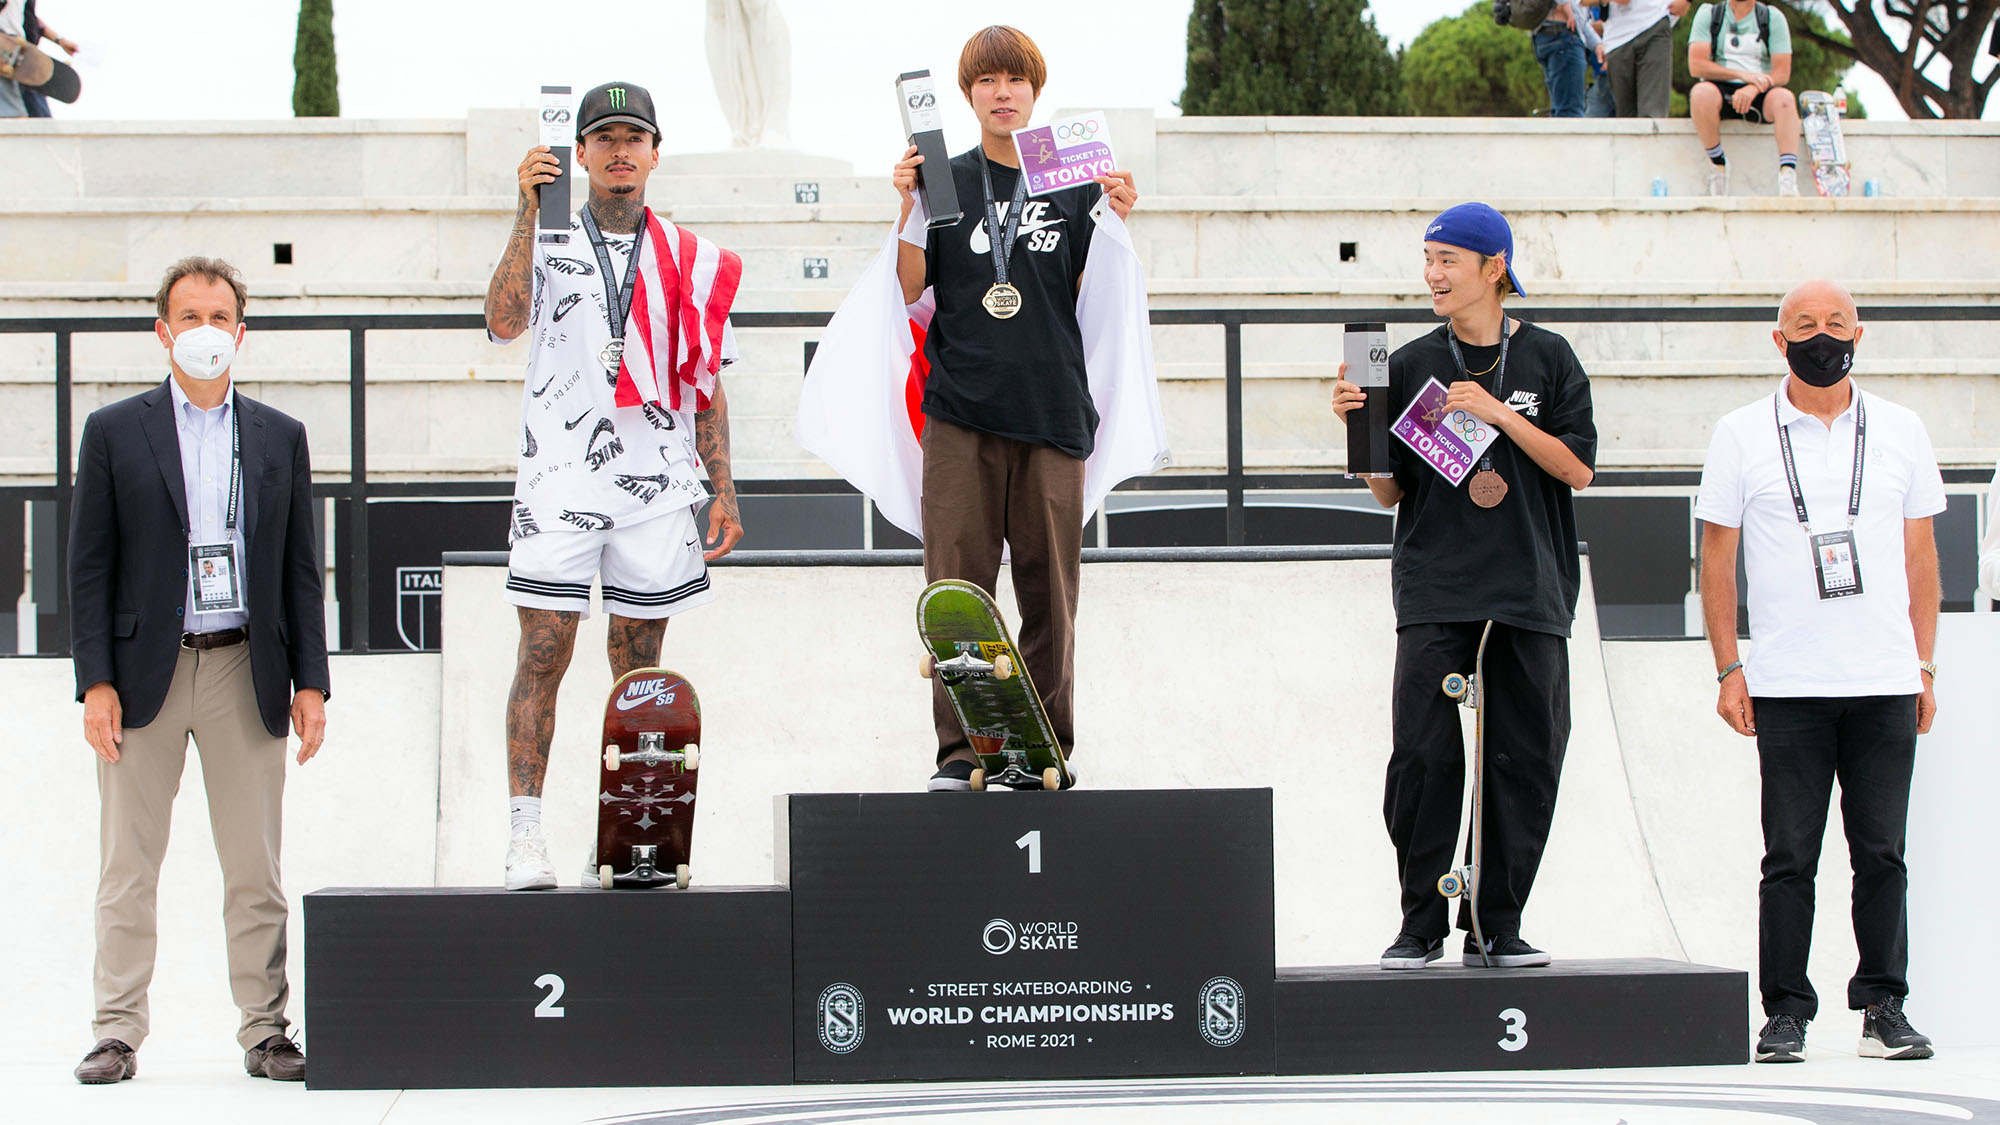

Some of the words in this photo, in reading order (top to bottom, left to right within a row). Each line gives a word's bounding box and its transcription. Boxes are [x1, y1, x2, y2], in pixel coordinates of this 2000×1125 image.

[1060, 150, 1095, 165] TICKET
[1096, 147, 1109, 156] TO
[1044, 159, 1114, 186] TOKYO
[796, 183, 818, 193] FILA
[801, 192, 816, 203] 10
[1027, 229, 1061, 253] SB
[805, 258, 828, 268] FILA
[811, 267, 821, 279] 9
[558, 293, 583, 309] NIKE
[563, 370, 583, 392] JUST
[543, 400, 552, 411] IT
[1510, 390, 1538, 405] NIKE
[1526, 406, 1539, 417] SB
[586, 436, 625, 473] NIKE
[1410, 427, 1464, 478] TOKYO
[1433, 430, 1461, 455] TICKET
[1460, 452, 1471, 465] TO
[528, 471, 544, 490] JUST
[548, 464, 559, 473] DO
[613, 477, 660, 505] NIKE
[559, 509, 596, 531] NIKE
[405, 574, 442, 588] ITAL
[625, 678, 667, 697] NIKE
[656, 693, 676, 706] SB
[1015, 831, 1042, 873] 1
[1019, 921, 1078, 935] WORLD
[1019, 935, 1078, 950] SKATE
[534, 974, 565, 1017] 2
[928, 983, 988, 997] STREET
[992, 981, 1133, 996] SKATEBOARDING
[887, 1007, 974, 1025] WORLD
[980, 1003, 1174, 1024] CHAMPIONSHIPS
[1497, 1008, 1528, 1051] 3
[987, 1034, 1036, 1048] ROME
[1040, 1034, 1075, 1048] 2021
